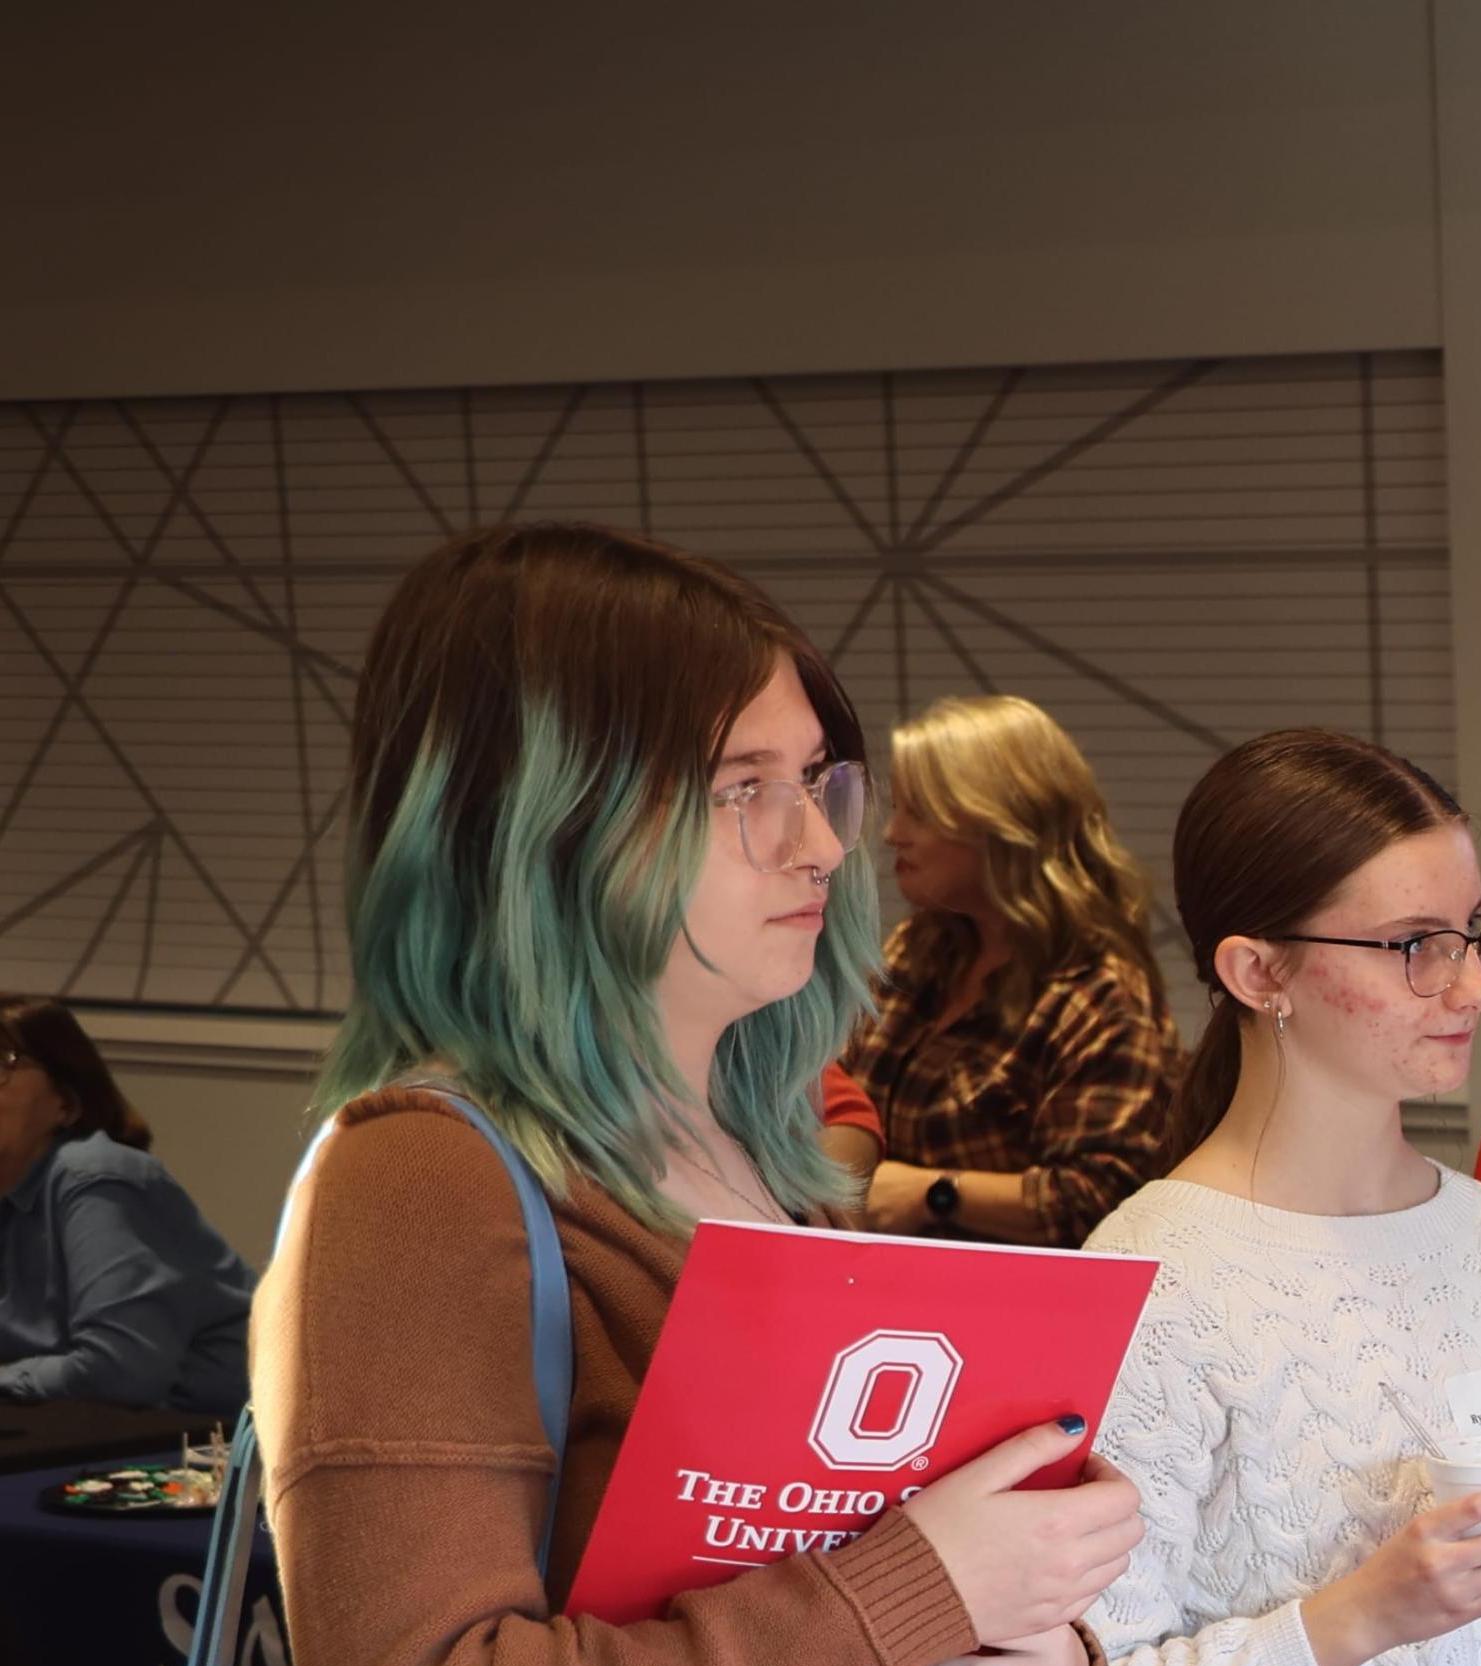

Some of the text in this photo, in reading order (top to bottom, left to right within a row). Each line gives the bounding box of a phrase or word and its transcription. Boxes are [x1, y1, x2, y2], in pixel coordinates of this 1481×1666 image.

[677, 1469, 766, 1509] THE
[779, 1482, 884, 1514] OHIO
[705, 1515, 858, 1553] UNIVE
